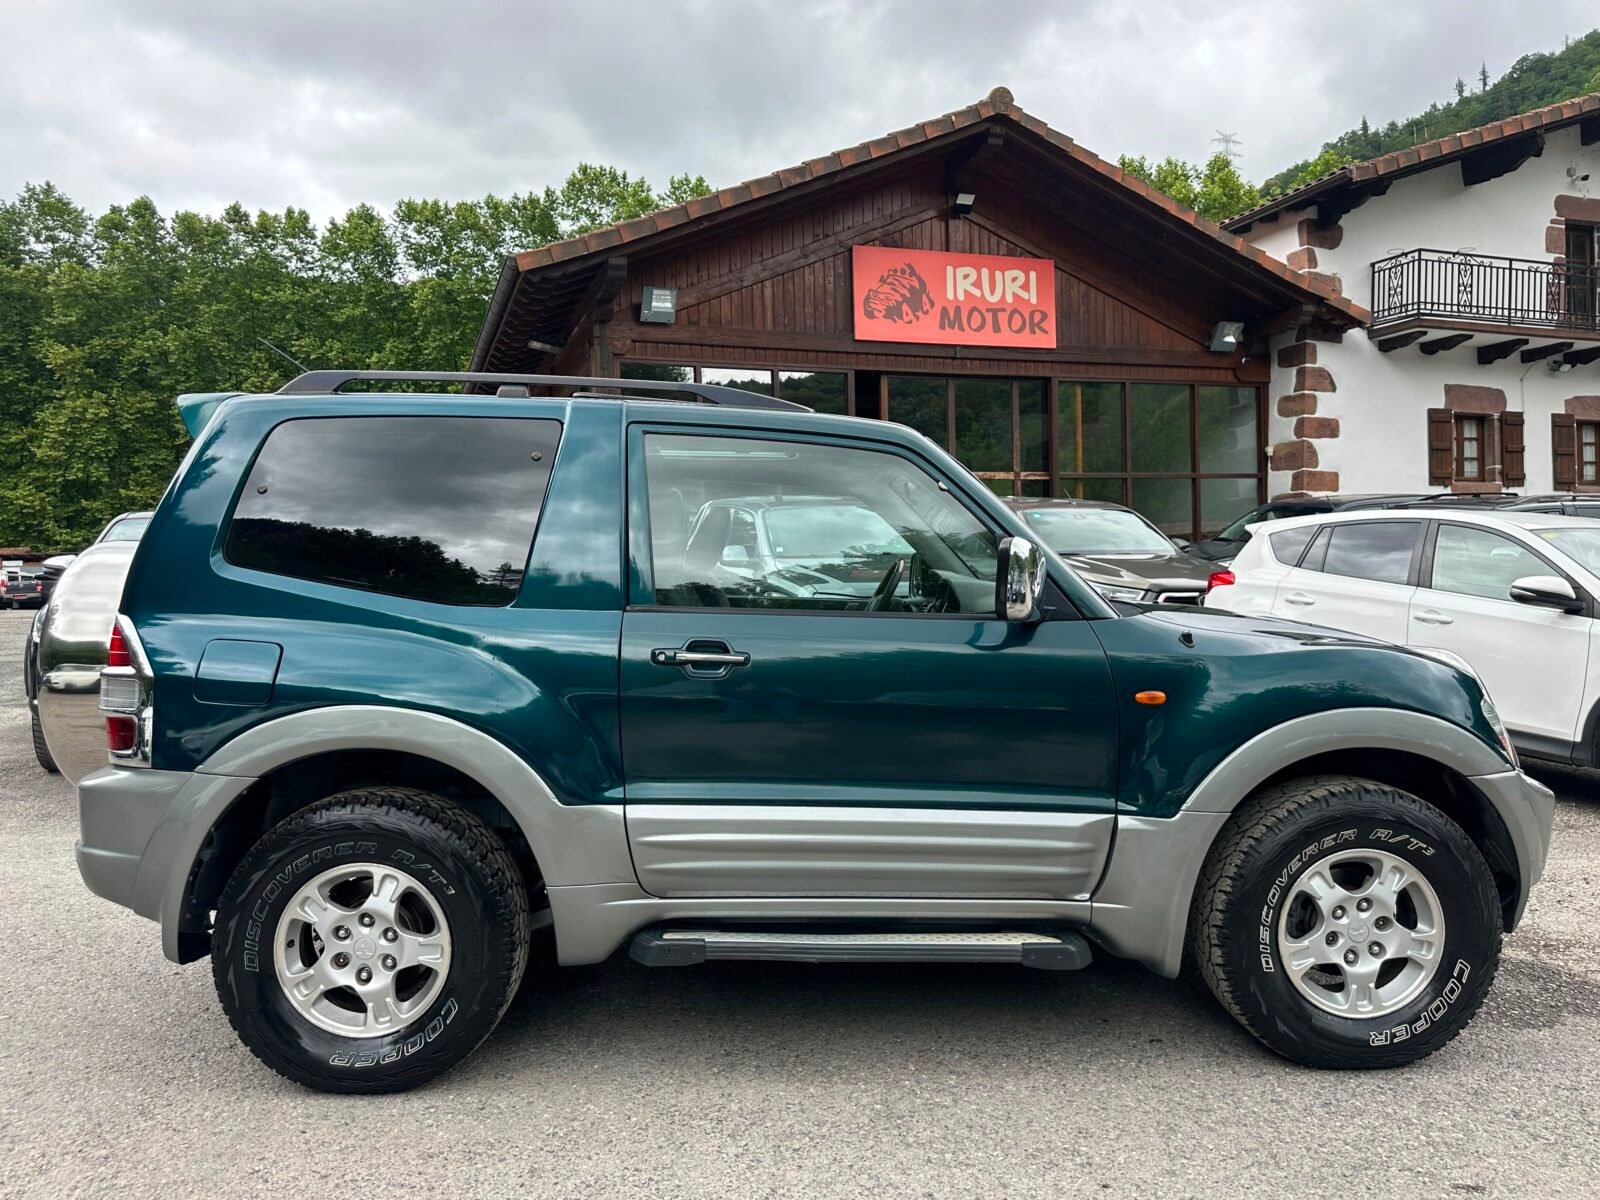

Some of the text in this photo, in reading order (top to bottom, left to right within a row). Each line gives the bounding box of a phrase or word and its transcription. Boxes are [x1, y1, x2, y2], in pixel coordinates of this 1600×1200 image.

[938, 305, 1049, 334] MOTOR
[946, 265, 1037, 304] IRURI
[244, 841, 378, 972] DISCOVERER
[1259, 829, 1357, 972] DISCOVERER
[329, 997, 458, 1067] COOPER
[1369, 959, 1471, 1046] COOPER
